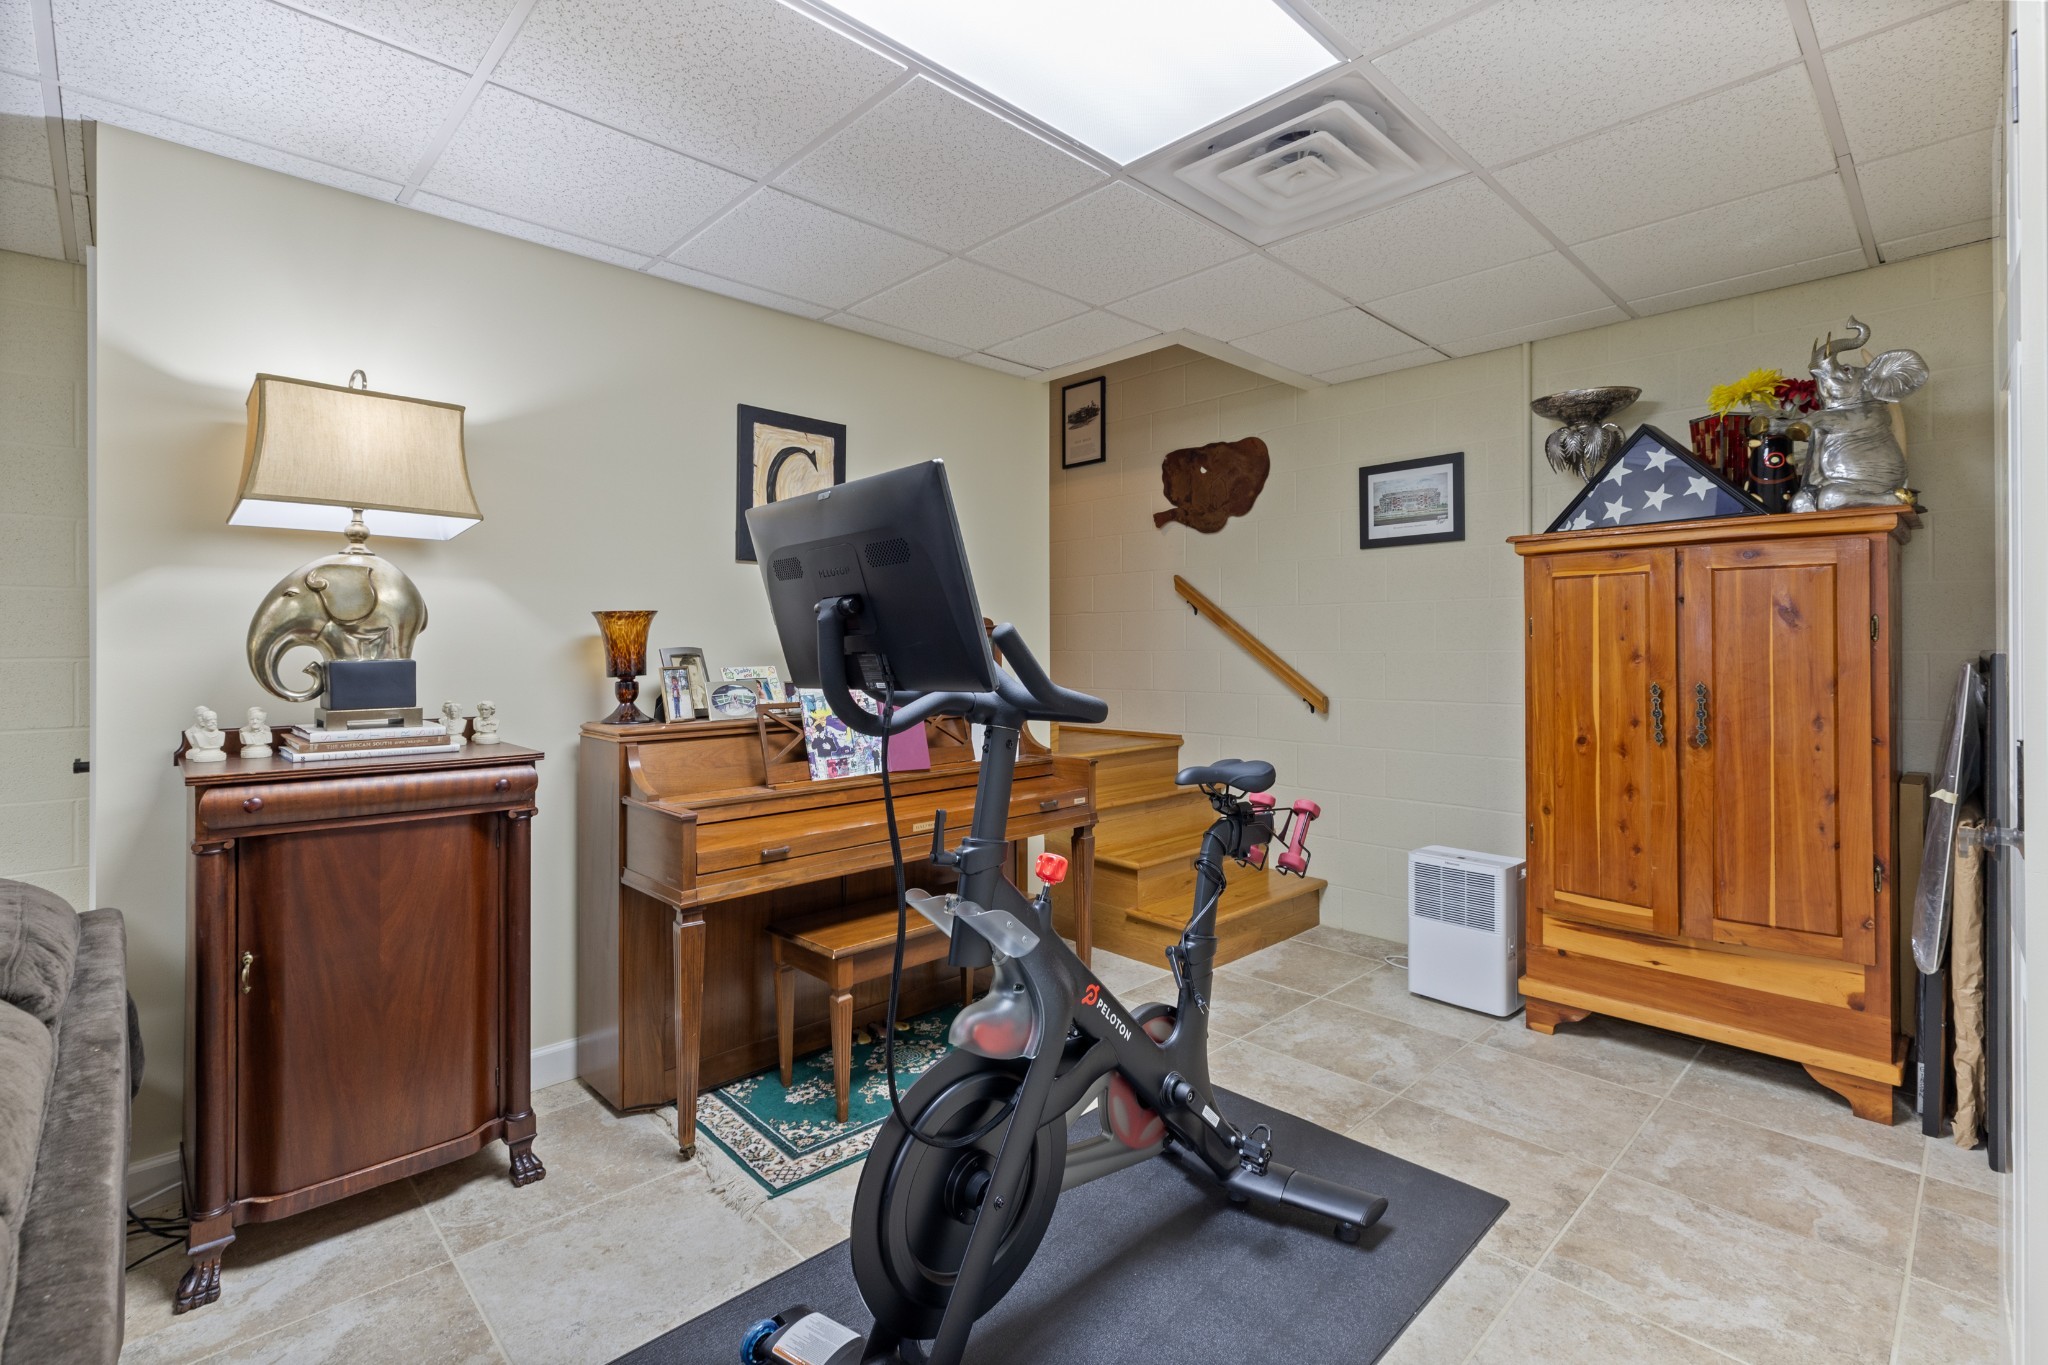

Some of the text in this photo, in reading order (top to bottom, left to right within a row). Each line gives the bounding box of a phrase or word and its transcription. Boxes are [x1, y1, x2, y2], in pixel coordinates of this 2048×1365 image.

[340, 741, 371, 749] AMERICAN
[372, 739, 392, 747] SOUTH
[1096, 998, 1131, 1041] PELOTON
